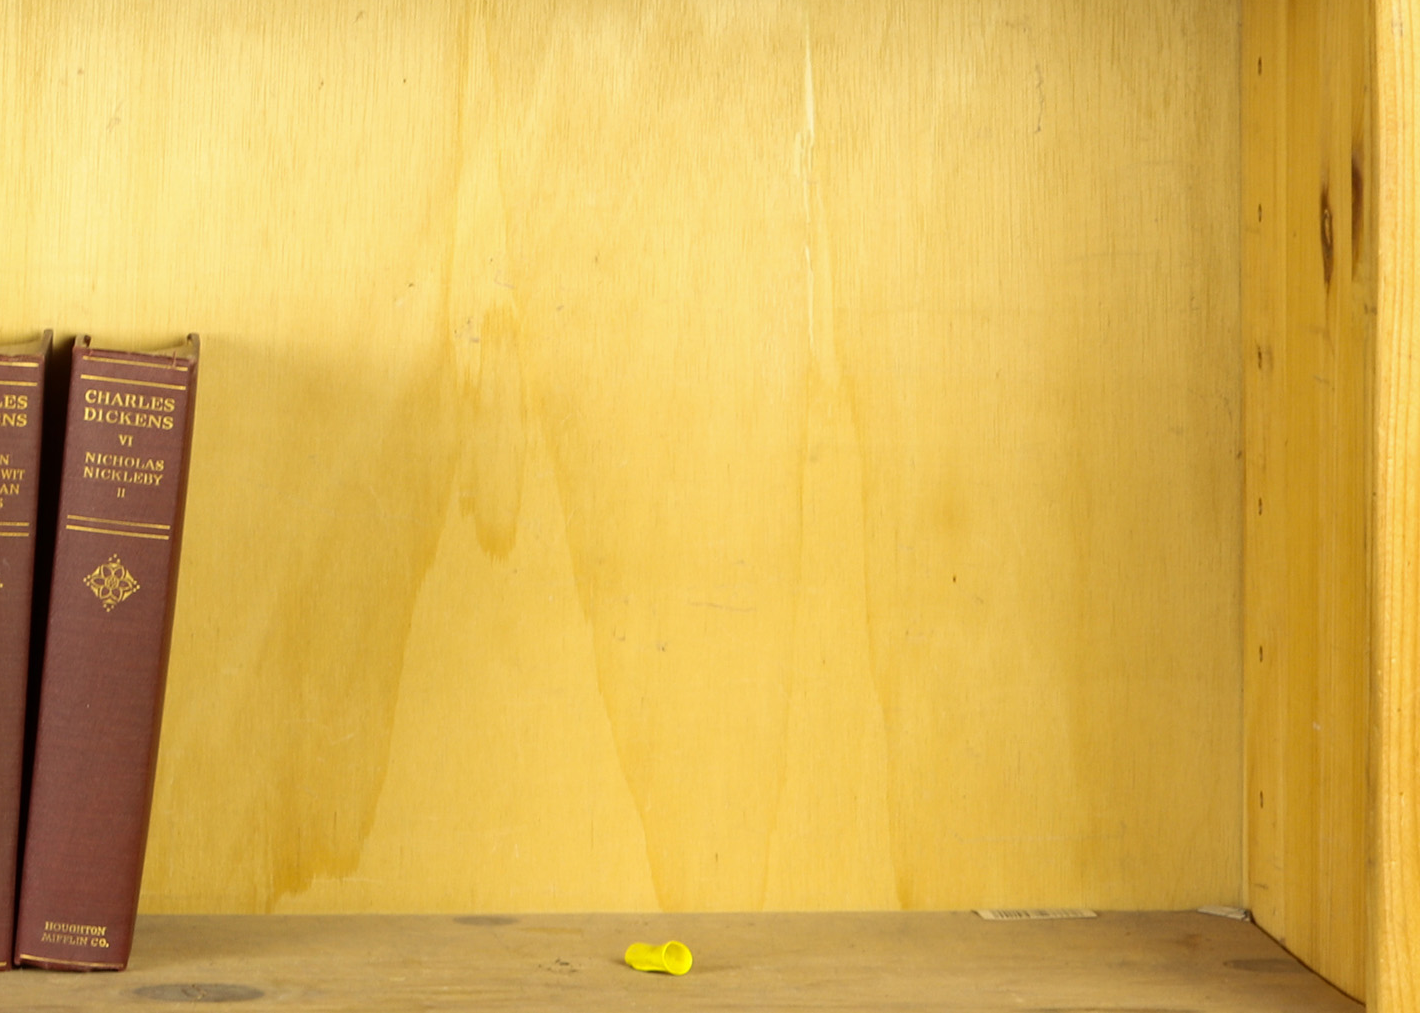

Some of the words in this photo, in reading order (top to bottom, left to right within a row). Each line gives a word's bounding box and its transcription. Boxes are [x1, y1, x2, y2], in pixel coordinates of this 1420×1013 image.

[85, 389, 175, 413] CHARLES
[83, 406, 174, 431] DICKENS
[85, 451, 164, 472] NICHOLAS
[83, 465, 163, 487] NICKLEBY
